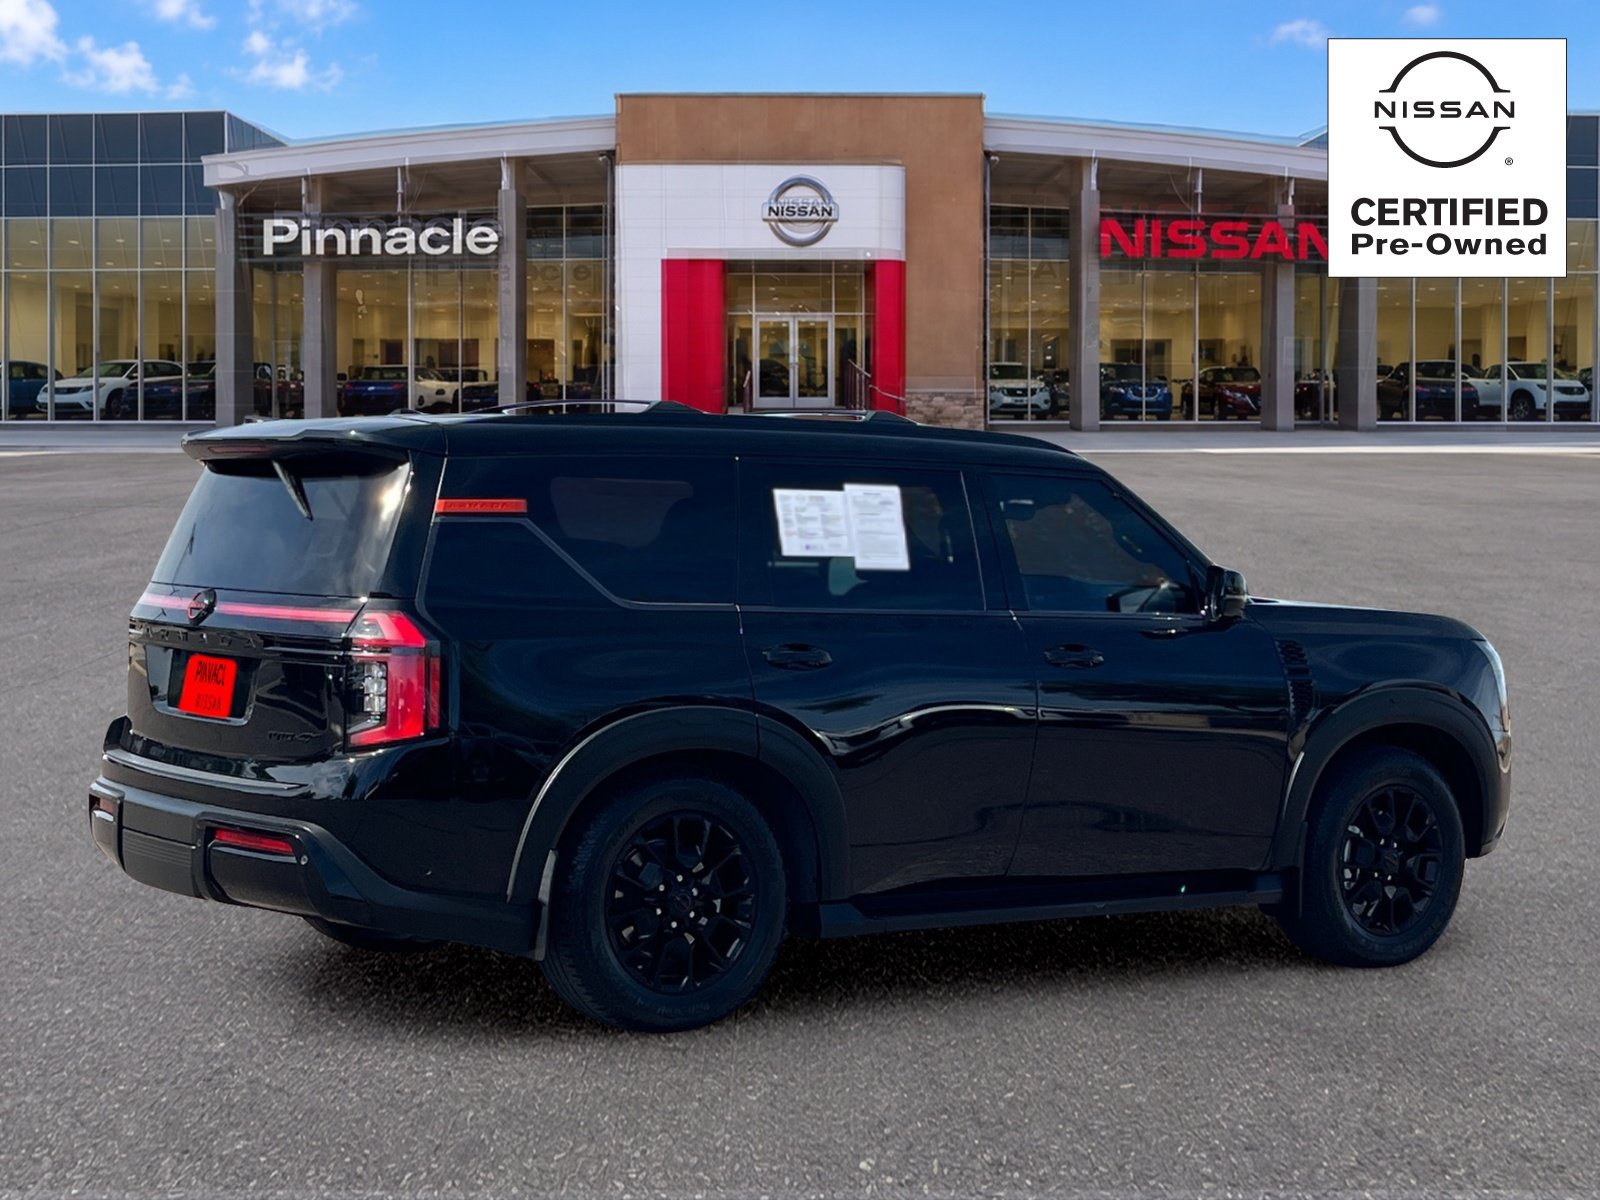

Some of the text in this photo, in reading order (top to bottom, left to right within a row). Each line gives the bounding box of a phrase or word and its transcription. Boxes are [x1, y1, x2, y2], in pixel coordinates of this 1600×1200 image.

[767, 205, 833, 217] NISSAN
[263, 217, 499, 256] Pinnacle
[1100, 217, 1328, 261] NISSAN
